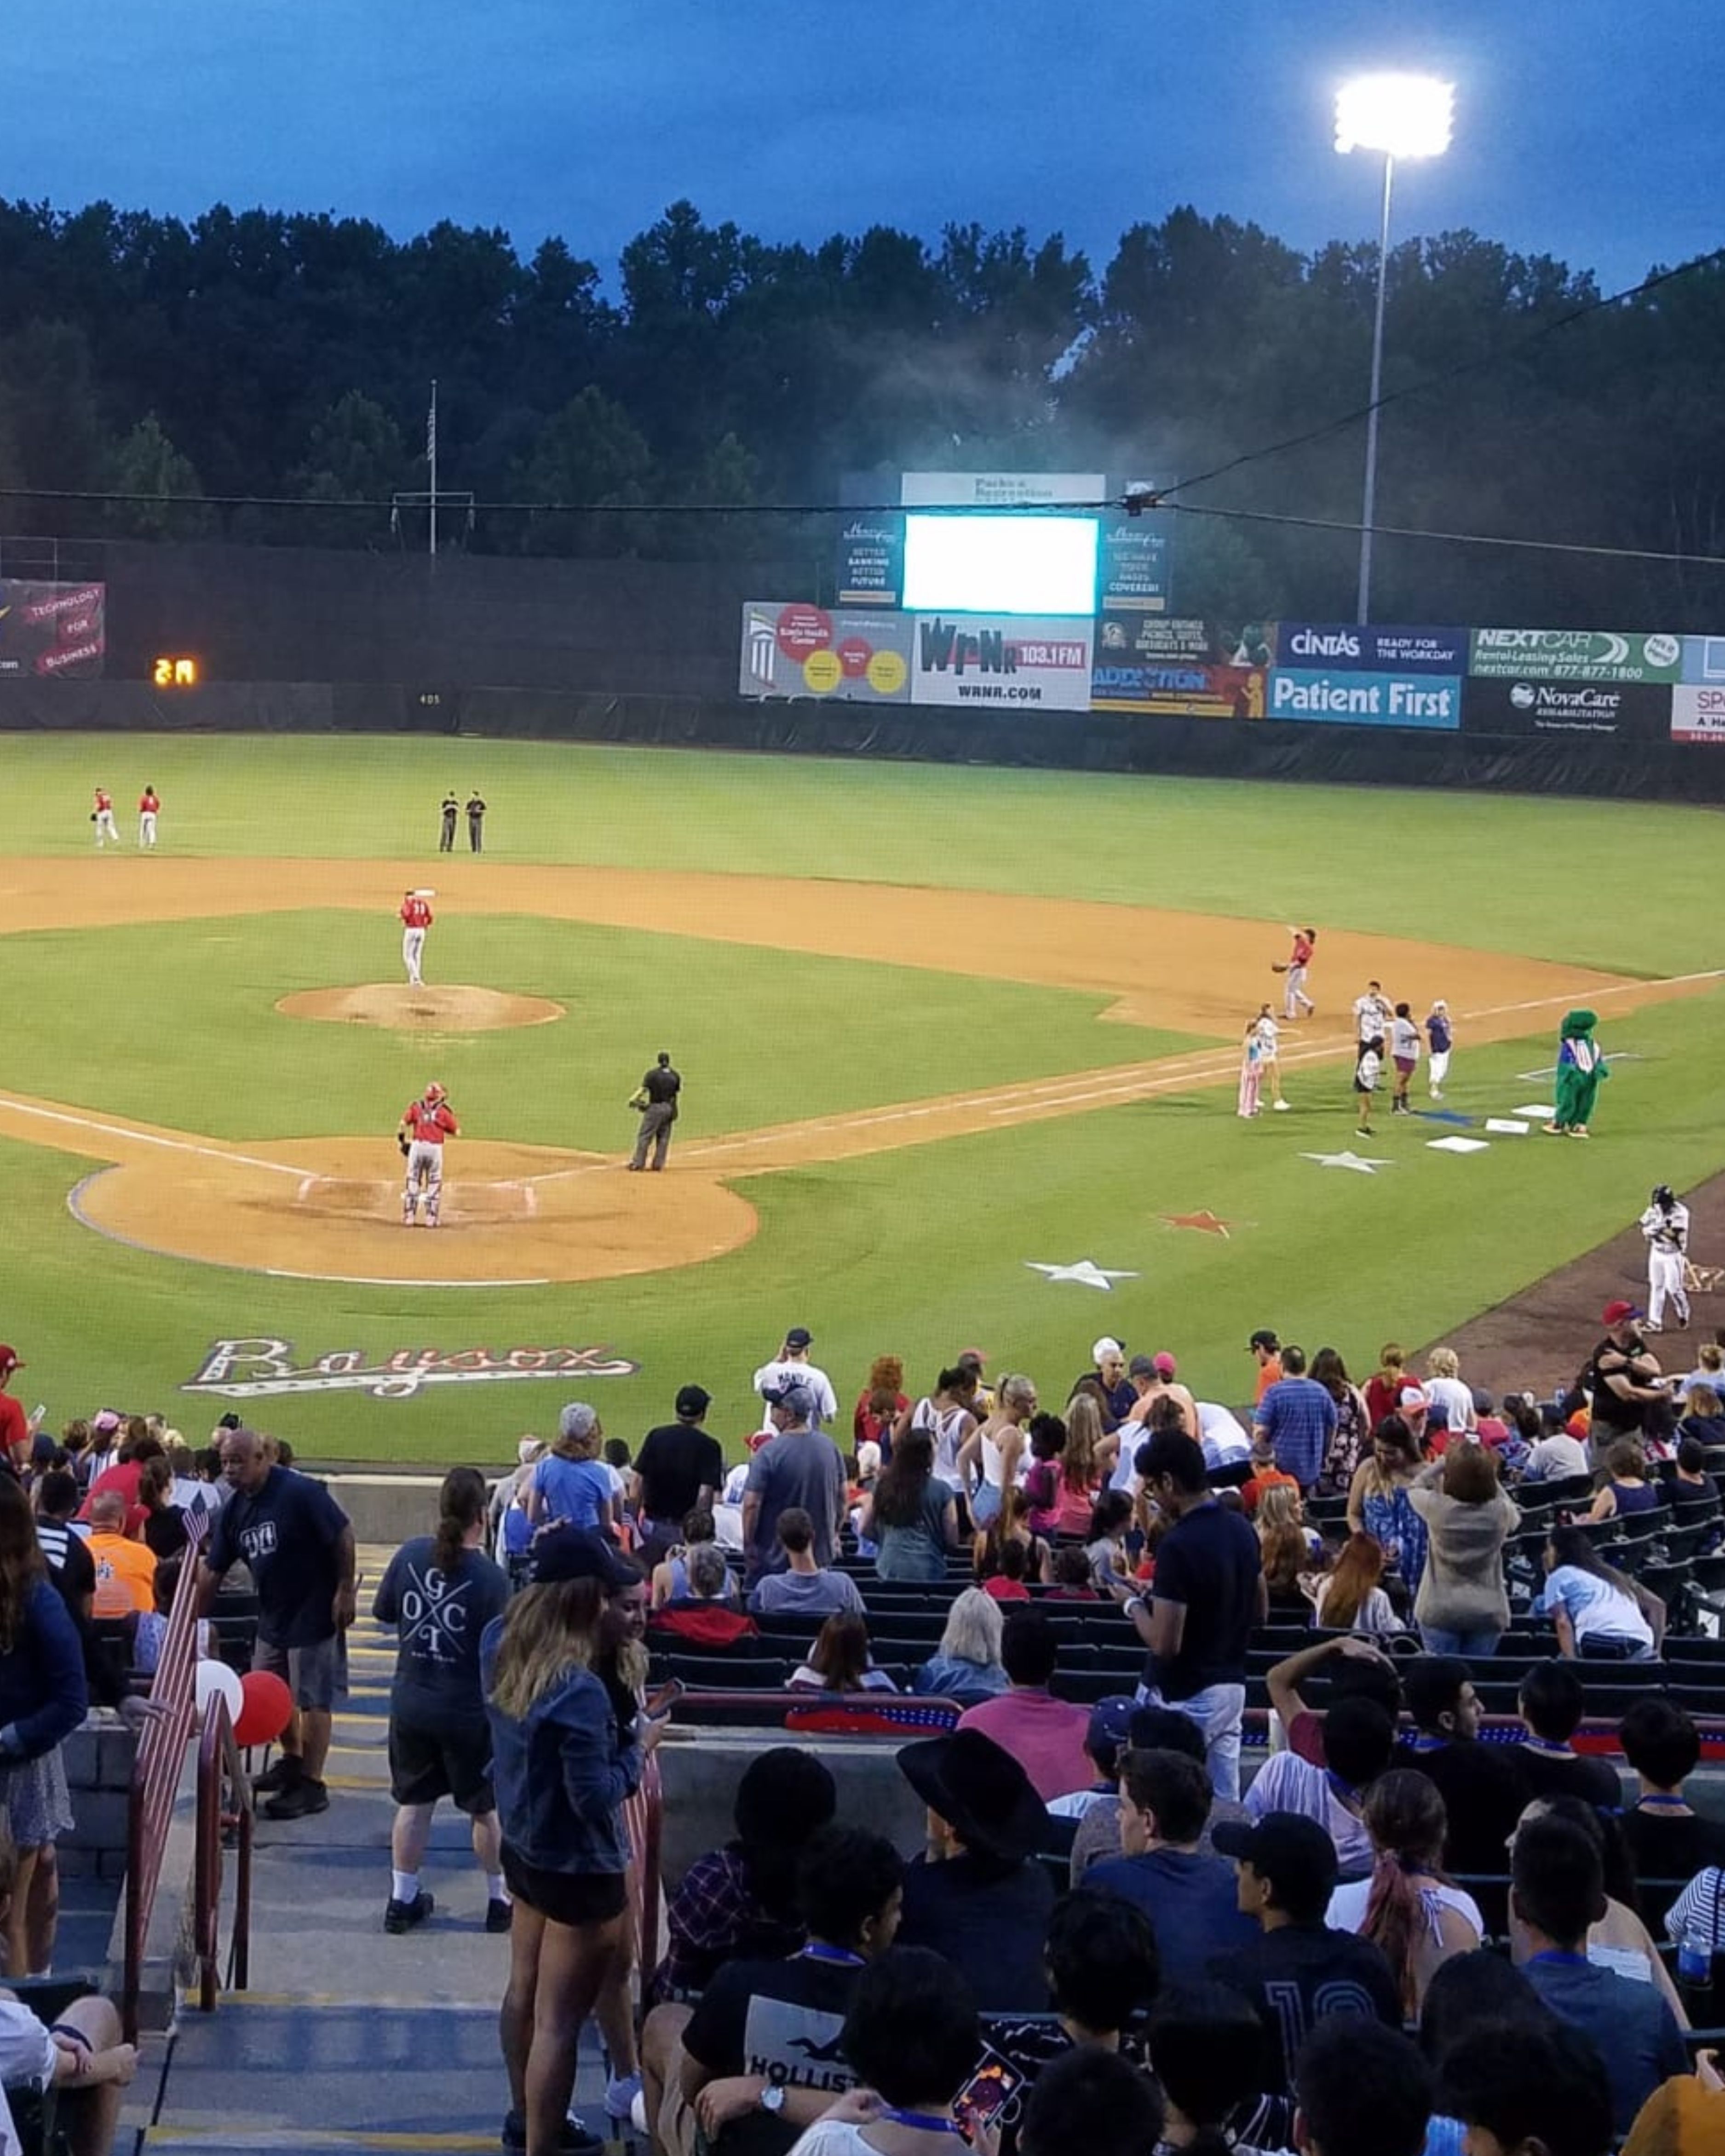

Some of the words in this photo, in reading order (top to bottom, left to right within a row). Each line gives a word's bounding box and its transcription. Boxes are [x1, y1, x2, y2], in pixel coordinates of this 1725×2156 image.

[31, 589, 99, 617] TECHNOLOGY
[67, 619, 88, 634] FOR
[1291, 628, 1360, 657] CINTAS
[1377, 638, 1413, 648] READY
[1415, 639, 1437, 648] FOR
[1477, 630, 1591, 648] NEXTCAR
[46, 644, 97, 667] BUSINESS
[1021, 646, 1057, 664] 103.1
[1059, 647, 1082, 665] FM
[1377, 649, 1397, 659] THE
[1400, 649, 1454, 661] WORKDAY
[1473, 664, 1549, 676] nextcar.com
[958, 686, 1042, 700] WRNR.COM
[1274, 677, 1380, 714] Patient
[1388, 682, 1450, 718] First
[1536, 687, 1622, 707] NovaCare
[186, 1337, 638, 1397] Baysox
